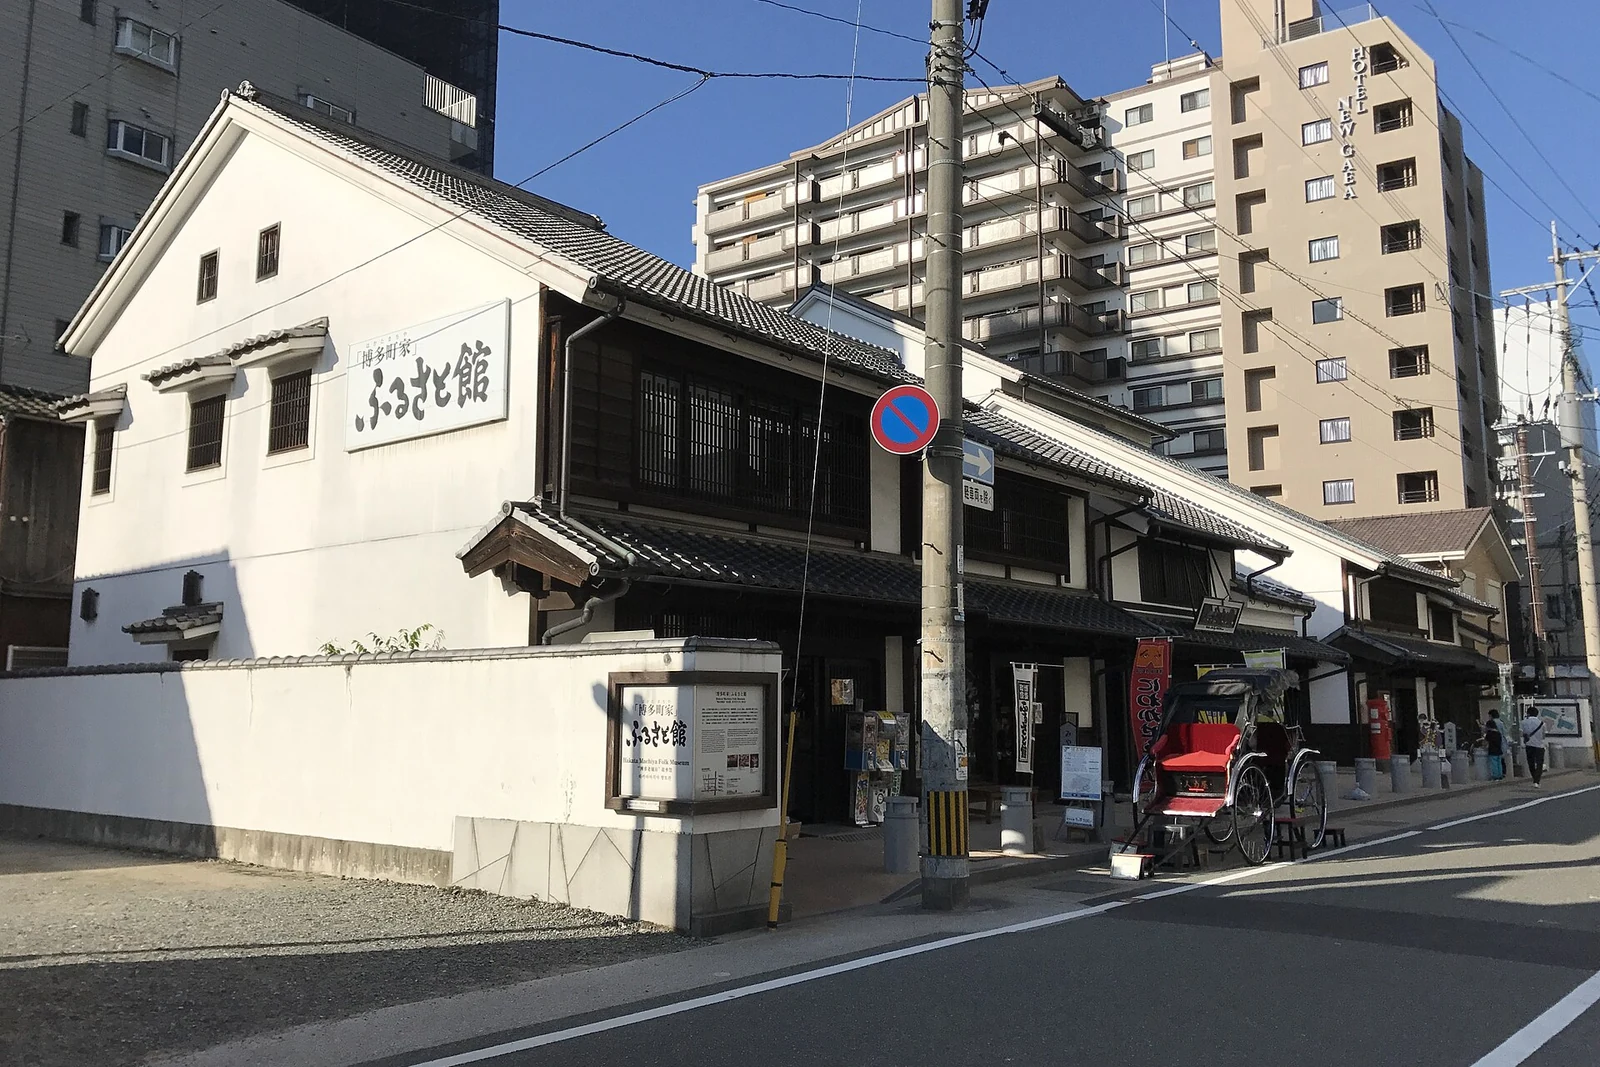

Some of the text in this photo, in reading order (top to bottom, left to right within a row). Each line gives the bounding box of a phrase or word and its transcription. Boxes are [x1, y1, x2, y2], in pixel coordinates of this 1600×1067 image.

[1352, 46, 1368, 114] HOTEL
[1338, 96, 1358, 200] NEW GAEA
[355, 340, 492, 432] ふるさと館
[626, 720, 688, 748] ふるさと館
